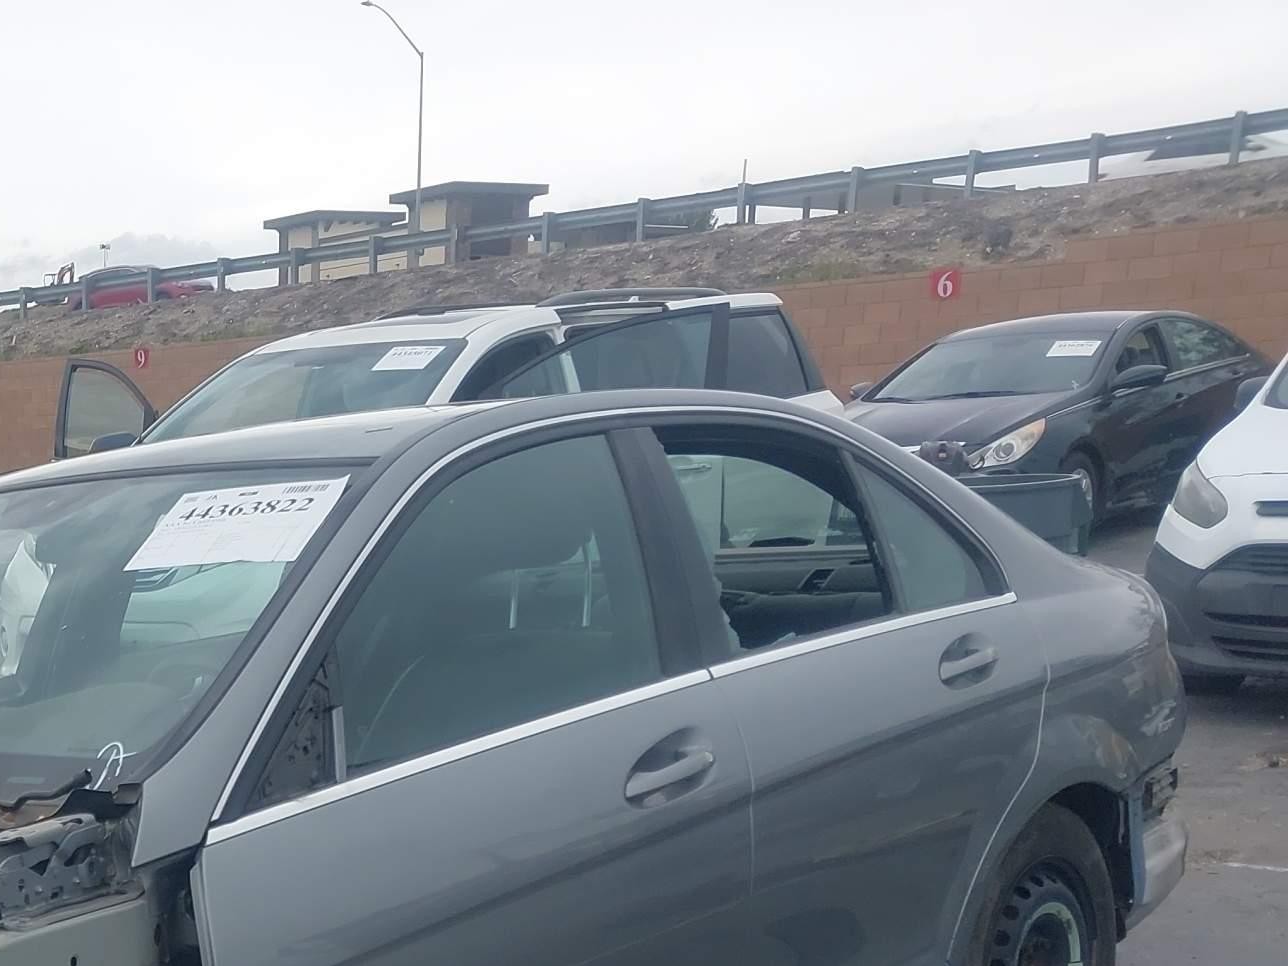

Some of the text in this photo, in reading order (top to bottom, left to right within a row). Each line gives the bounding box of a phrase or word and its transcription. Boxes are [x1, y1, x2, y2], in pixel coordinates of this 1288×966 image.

[937, 271, 952, 297] 6
[137, 350, 145, 368] 9
[179, 497, 314, 520] 44363822
